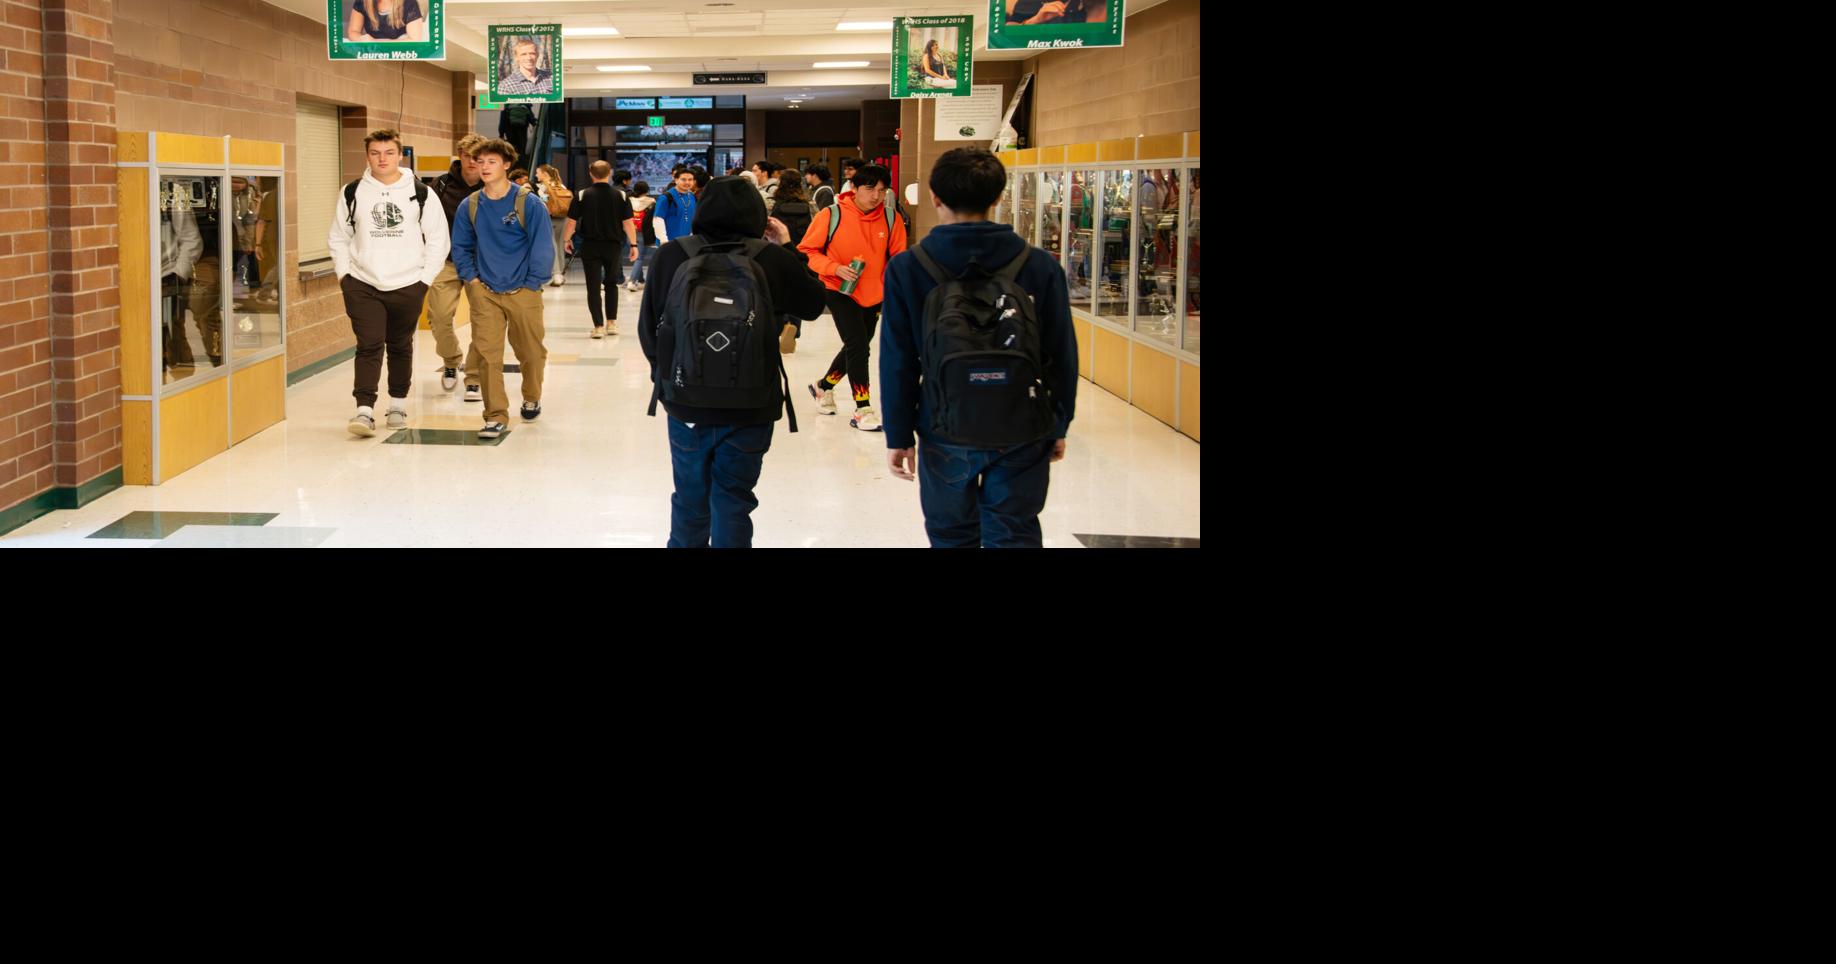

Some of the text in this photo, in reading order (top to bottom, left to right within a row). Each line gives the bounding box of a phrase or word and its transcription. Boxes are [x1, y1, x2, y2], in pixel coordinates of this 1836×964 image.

[1027, 39, 1083, 48] Max Kwok
[357, 50, 418, 59] Lauren Webb
